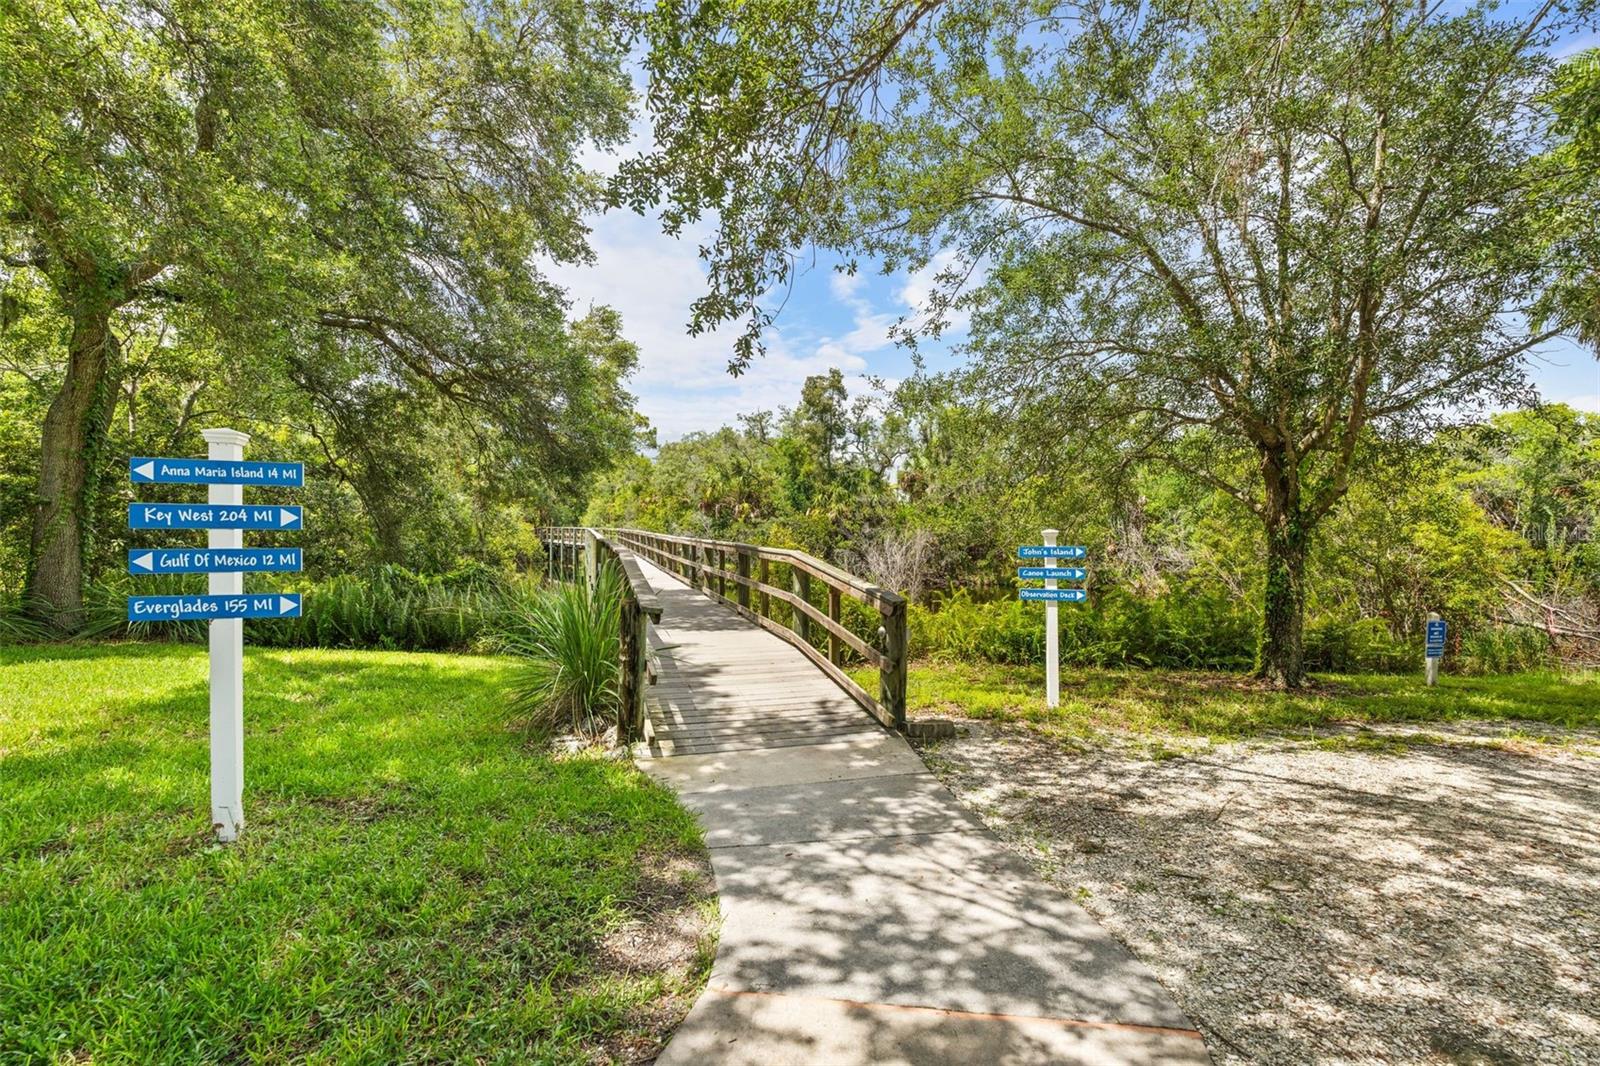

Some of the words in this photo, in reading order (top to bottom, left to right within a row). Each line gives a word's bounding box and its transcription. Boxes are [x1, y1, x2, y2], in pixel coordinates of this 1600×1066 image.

[160, 464, 190, 477] Anna
[195, 467, 227, 478] Maria
[231, 467, 264, 479] Island
[268, 469, 278, 479] 14
[283, 469, 297, 479] MI
[144, 507, 172, 526] Key
[178, 509, 213, 522] West
[219, 509, 248, 522] 204
[254, 510, 273, 522] MI
[1051, 548, 1074, 556] Island
[160, 553, 190, 568] Gulf
[194, 553, 210, 567] Of
[214, 555, 257, 567] Mexico
[262, 555, 275, 566] 12
[280, 553, 296, 566] MI
[1022, 569, 1044, 577] Canoe
[134, 599, 218, 619] Everglades
[225, 599, 247, 612] 155
[254, 598, 273, 611] MI
